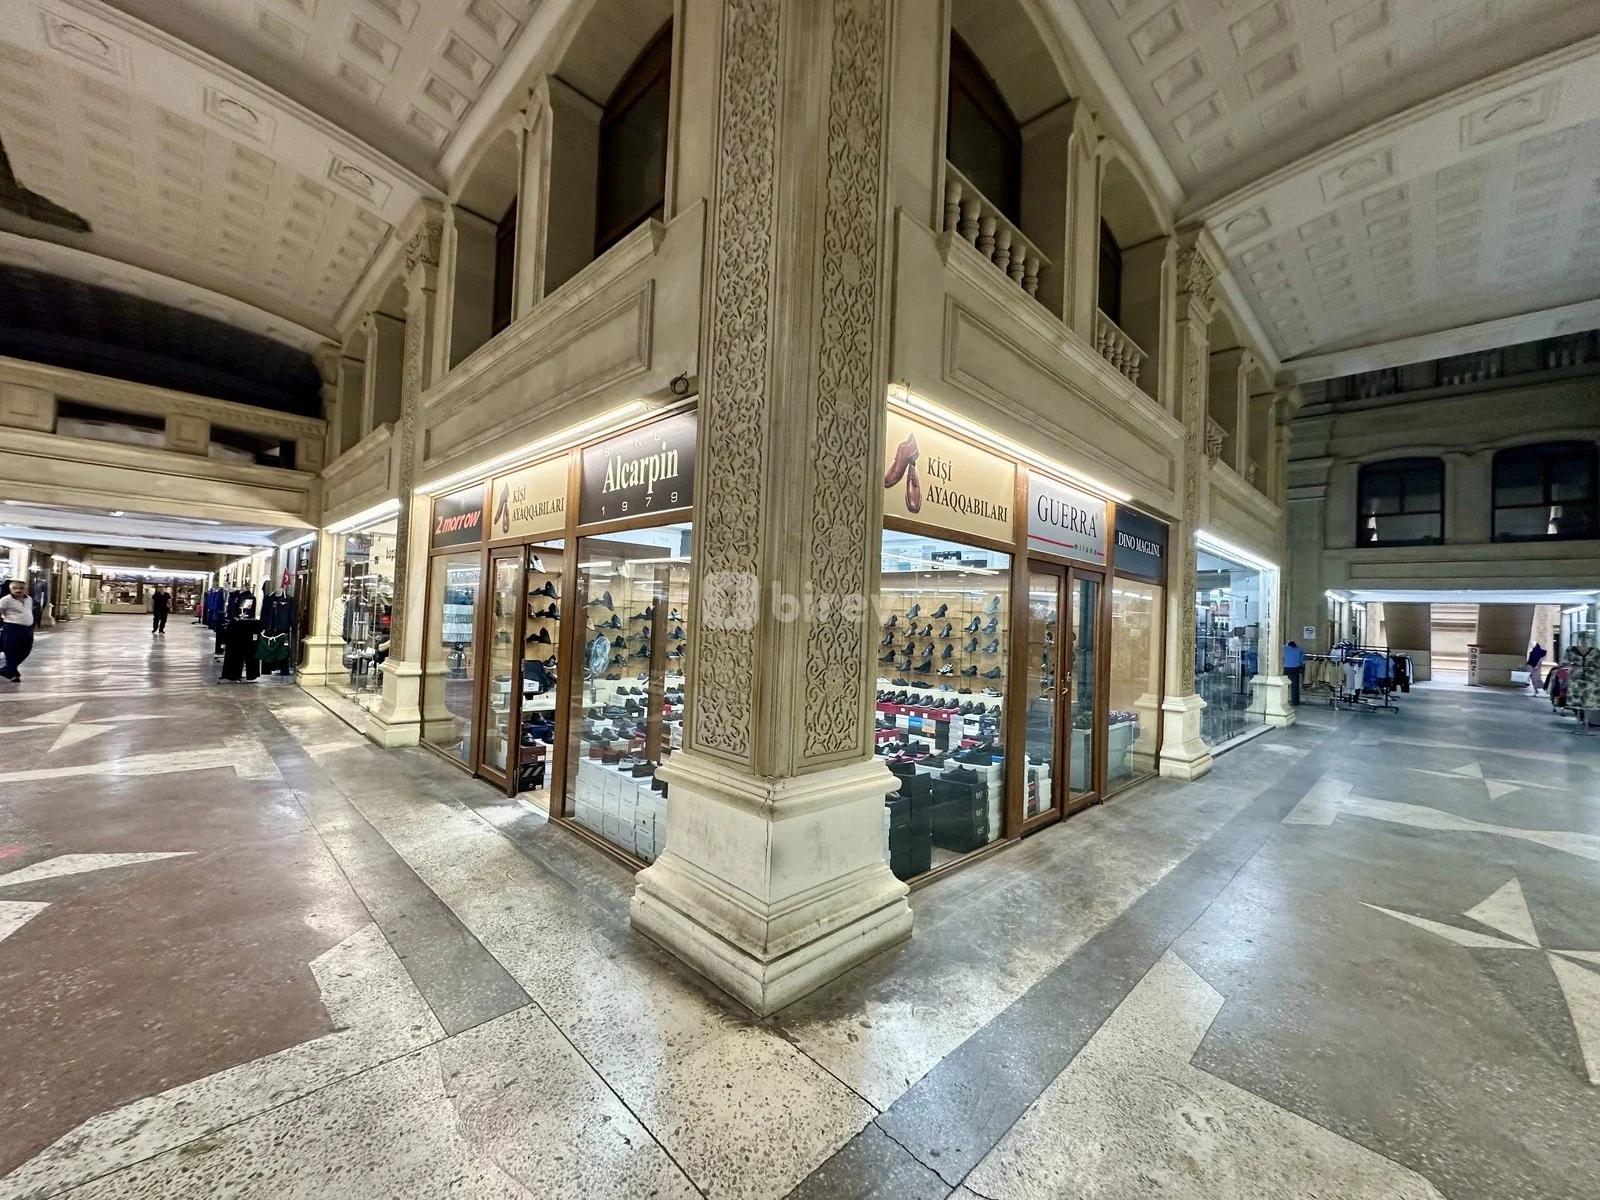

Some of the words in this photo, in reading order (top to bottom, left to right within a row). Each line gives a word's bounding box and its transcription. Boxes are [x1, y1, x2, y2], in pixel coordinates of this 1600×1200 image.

[602, 441, 679, 494] Alcarpin
[927, 456, 952, 485] KİŞİ
[511, 497, 564, 522] AYAQQABILARI
[601, 491, 678, 515] 1979
[926, 484, 1008, 523] AYAQQABILARI
[1037, 494, 1097, 538] GUERRA
[1118, 531, 1136, 550] DINO
